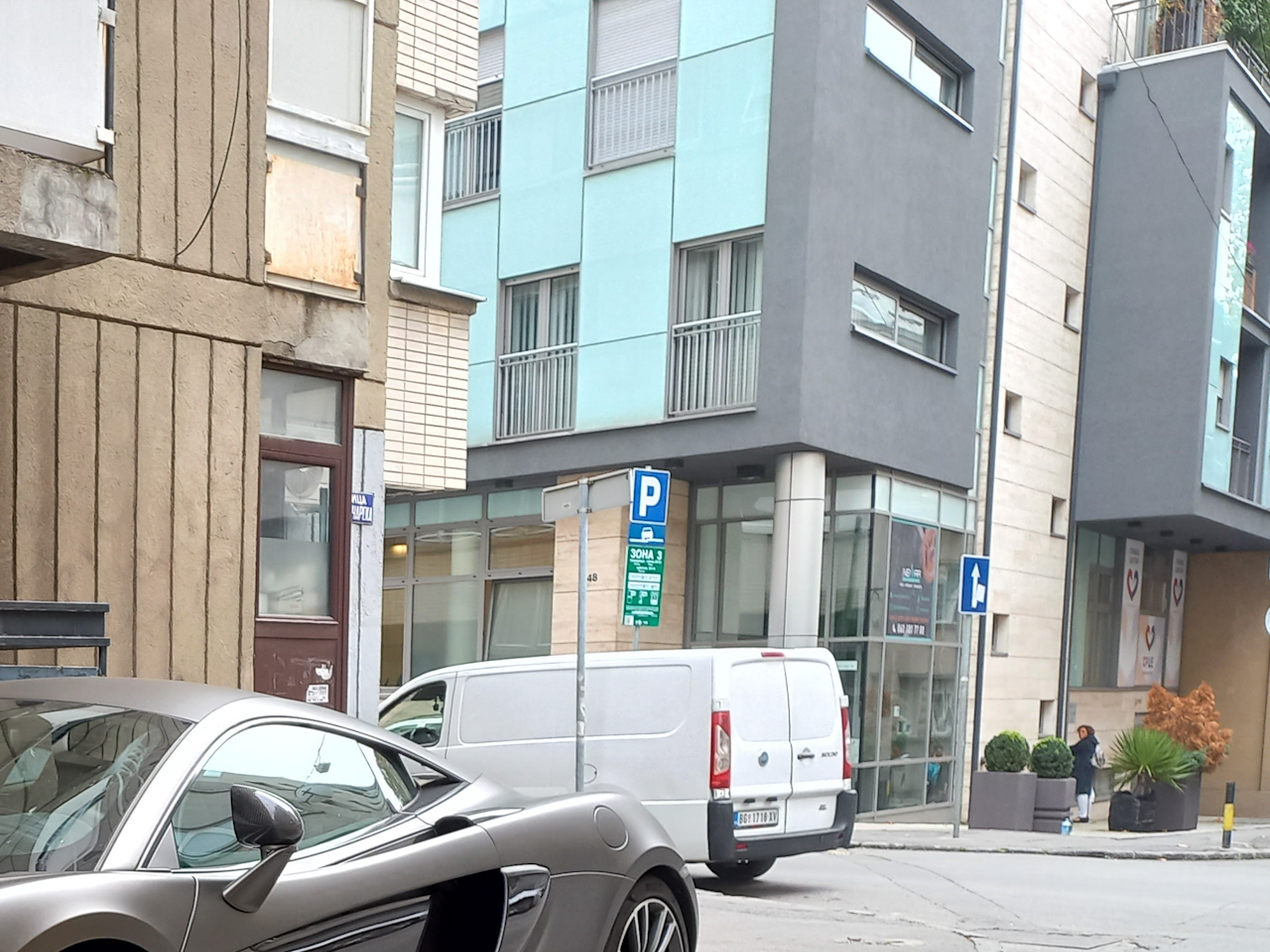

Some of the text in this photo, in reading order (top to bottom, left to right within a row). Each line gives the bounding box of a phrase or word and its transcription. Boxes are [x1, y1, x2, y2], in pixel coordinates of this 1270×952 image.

[638, 475, 662, 517] P
[630, 548, 663, 560] ЗОНА 3
